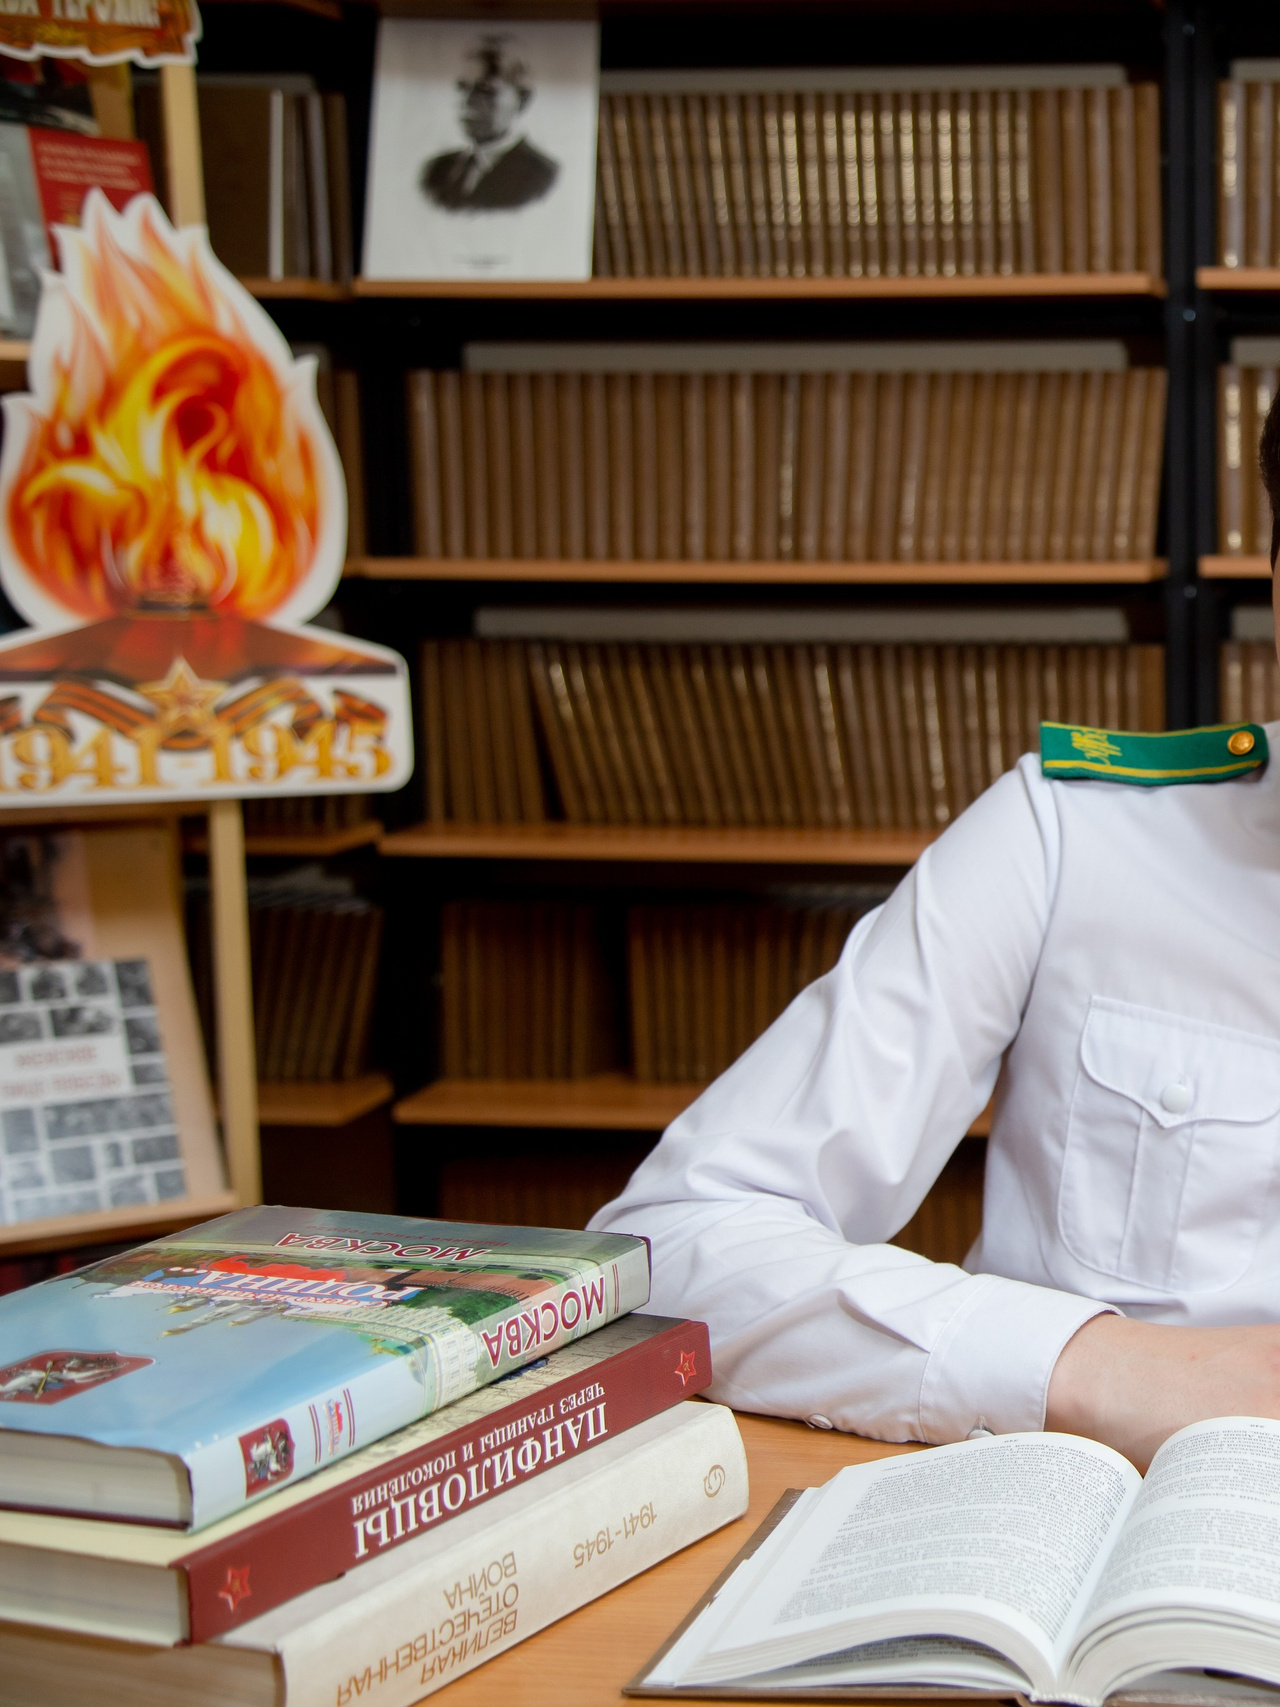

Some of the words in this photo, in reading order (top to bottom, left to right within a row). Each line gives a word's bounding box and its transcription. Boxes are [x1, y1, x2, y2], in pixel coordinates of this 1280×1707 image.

[0, 719, 395, 789] 941-1945
[273, 1232, 492, 1262] МОСКВА
[479, 1275, 605, 1369] МОСКВА
[480, 1404, 555, 1454] ГРАНИЦЫ
[559, 1382, 605, 1414] ЧЕРЕЗ
[353, 1402, 608, 1558] ПАНФИЛОВЦЫ
[462, 1442, 474, 1462] И
[352, 1454, 457, 1515] ПОКОЛЕНИЯ
[573, 1501, 658, 1568] 1941-1945
[442, 1551, 518, 1610] ВОЙНА
[337, 1582, 519, 1706] ОТЕЧЕСТВЕННАЯ
[420, 1608, 518, 1686] ВЕЛИКАЯ
